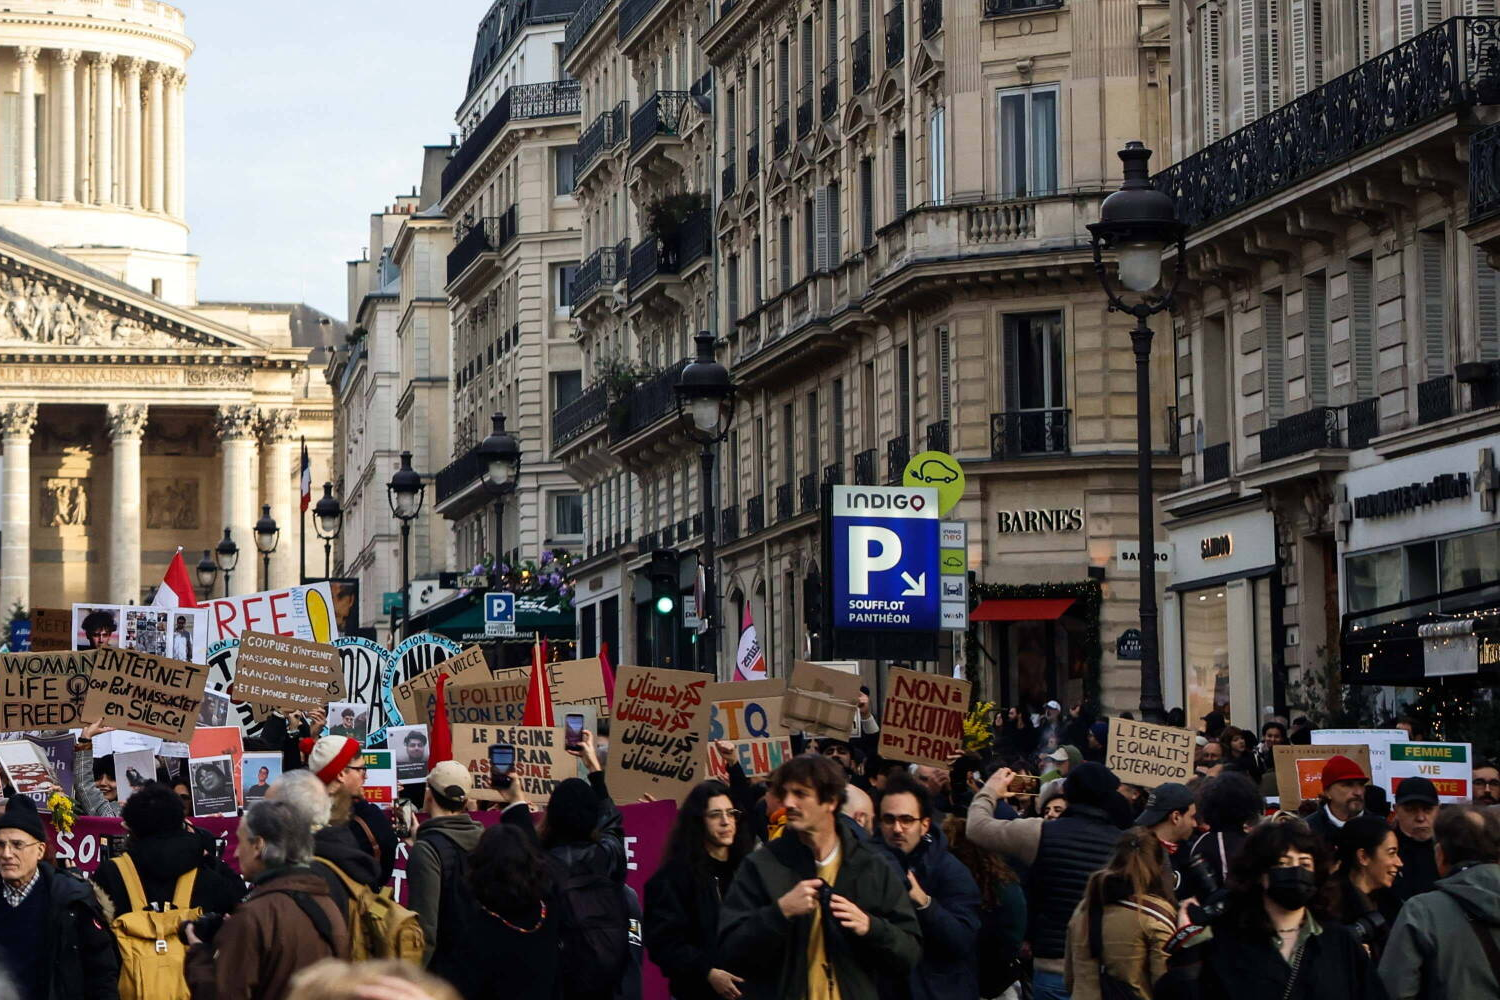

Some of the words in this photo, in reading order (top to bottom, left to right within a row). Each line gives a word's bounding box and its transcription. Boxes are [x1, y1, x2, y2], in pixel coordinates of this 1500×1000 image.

[29, 367, 178, 384] RECONNAISSANTE
[847, 493, 925, 512] INDIGO
[997, 508, 1083, 533] BARNES
[848, 525, 903, 595] P
[1122, 552, 1168, 562] SARO
[493, 599, 506, 617] P
[849, 600, 905, 611] SOUFFLOT
[849, 611, 910, 624] PANTHÉON
[247, 636, 290, 654] COUPURE
[4, 653, 98, 675] WOMAN
[97, 648, 201, 689] INTERNET
[242, 653, 282, 667] MASSACRE
[382, 634, 426, 688] REVOLUTION
[448, 651, 482, 676] VOICE
[238, 684, 248, 692] ET
[251, 685, 260, 695] LE
[895, 675, 951, 706] NON
[105, 701, 124, 717] en
[428, 704, 525, 726] PISONERS
[472, 728, 487, 744] LE
[496, 727, 554, 747] RÉGIME
[1116, 723, 1190, 748] LIBERTY
[904, 734, 959, 762] IRAN
[1117, 740, 1190, 764] EQUALITY
[1404, 747, 1453, 758] FEMME
[1109, 755, 1187, 778] SISTERHOOD
[1418, 764, 1441, 775] VIE
[472, 774, 492, 790] ES
